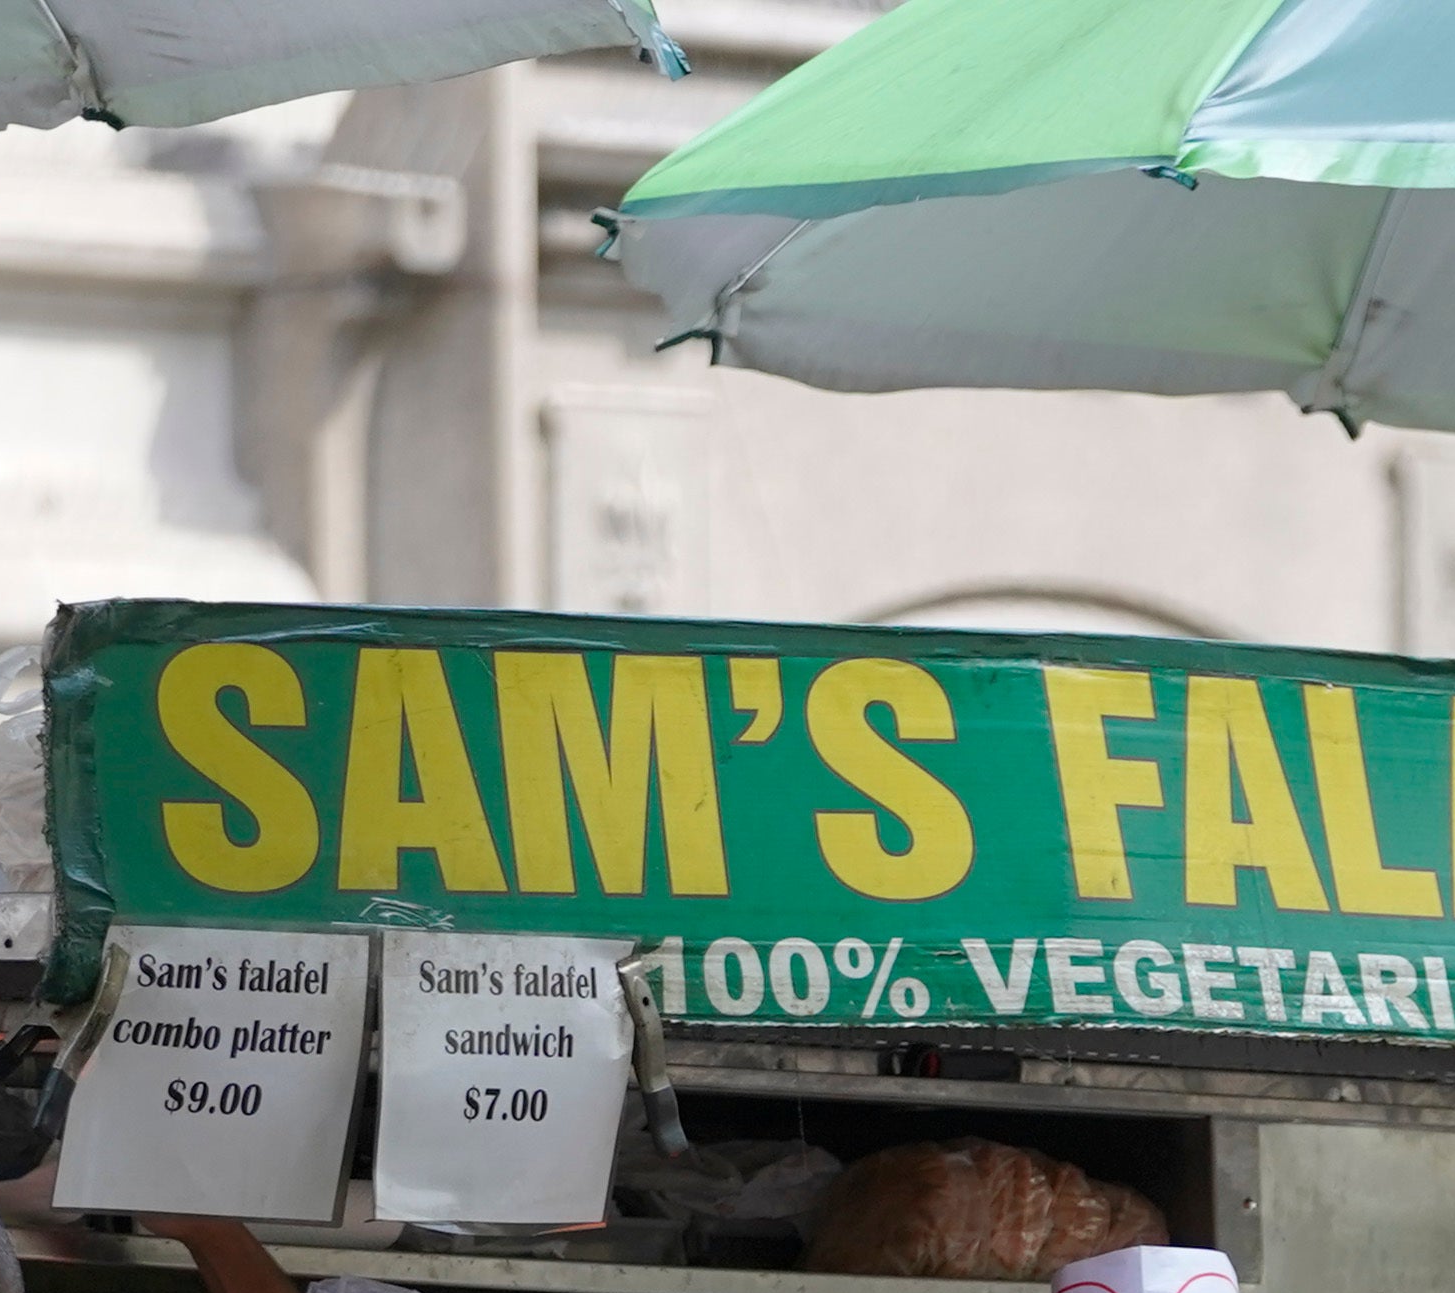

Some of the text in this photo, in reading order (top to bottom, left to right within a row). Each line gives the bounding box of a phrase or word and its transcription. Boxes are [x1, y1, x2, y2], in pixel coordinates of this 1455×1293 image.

[155, 641, 976, 903] SAM'S
[237, 956, 329, 996] falafel
[512, 964, 598, 999] falafel
[643, 935, 933, 1019] 100%
[112, 1017, 332, 1059] combo platter
[444, 1024, 574, 1058] sandwich
[163, 1078, 263, 1116] $9.00
[463, 1086, 549, 1123] $7.00
